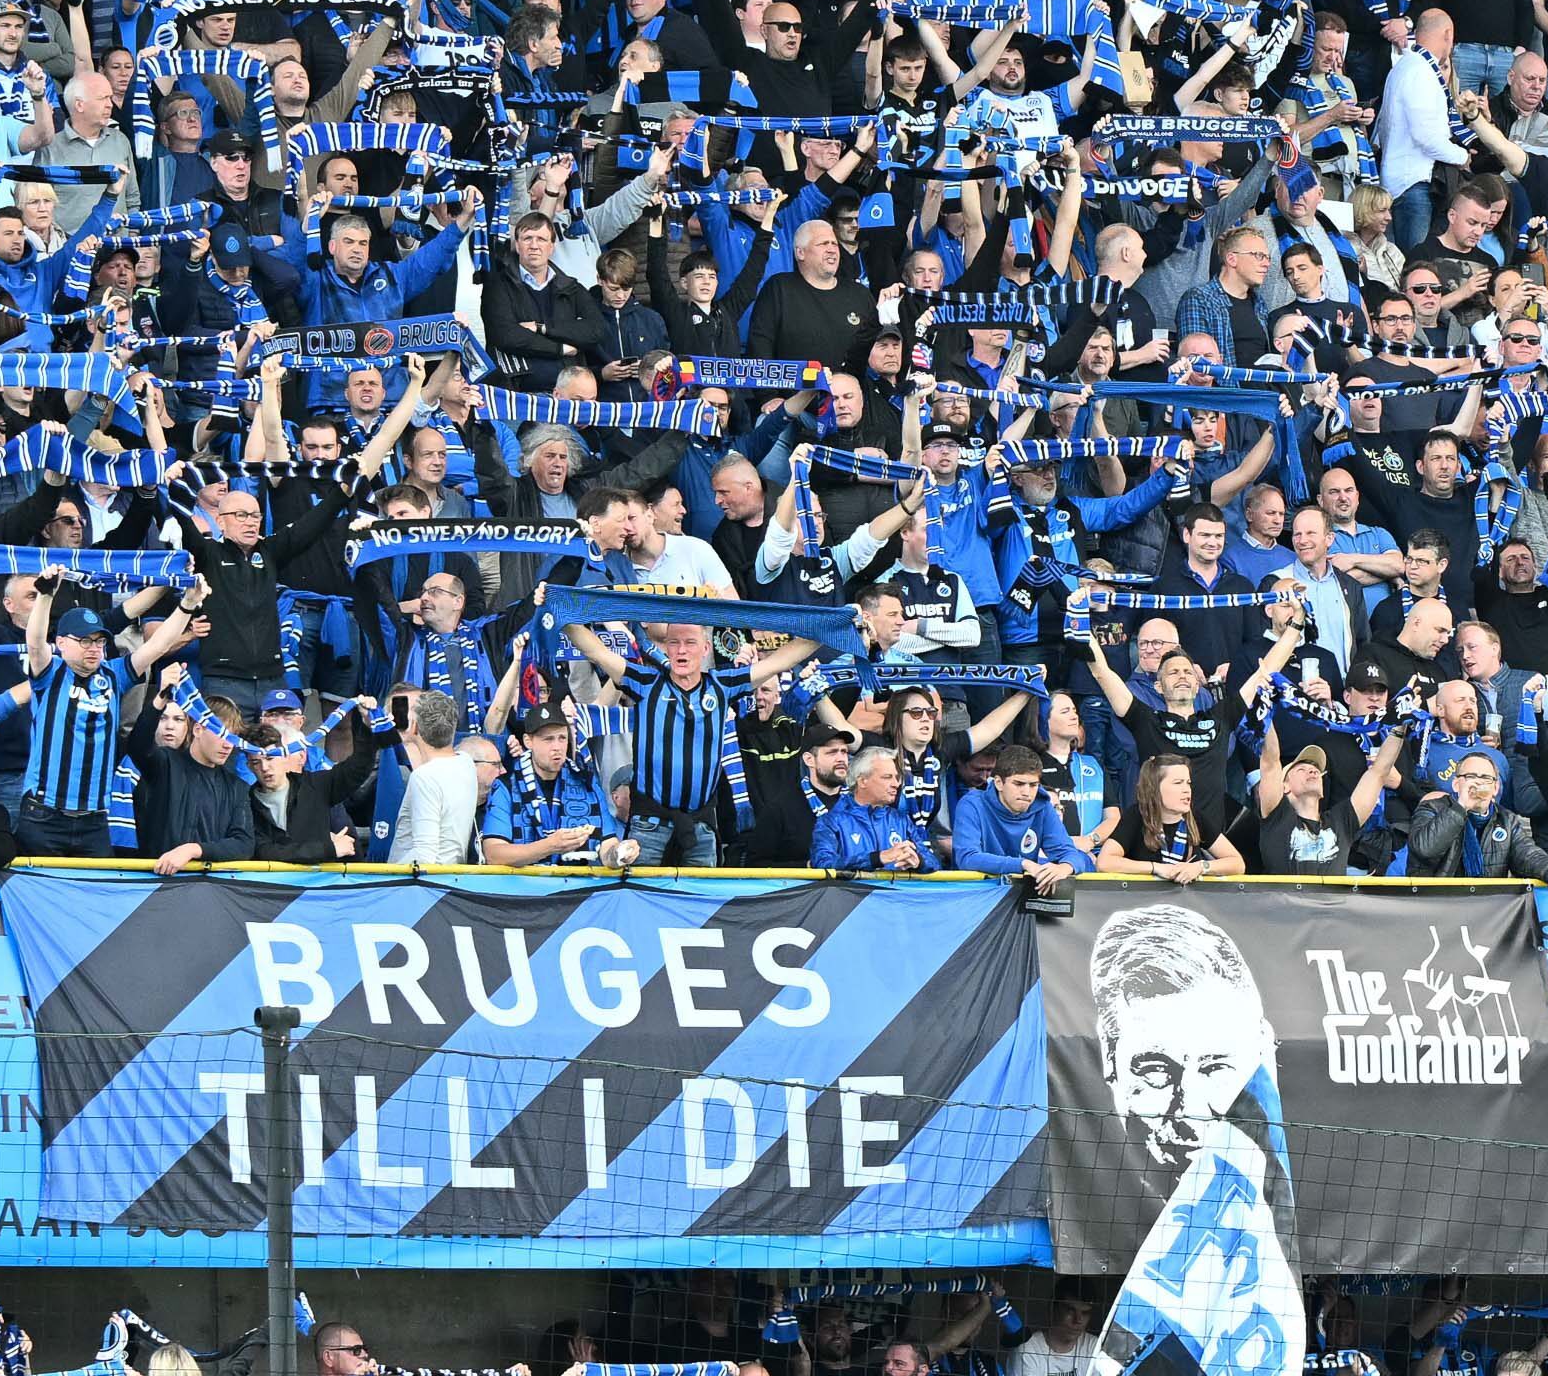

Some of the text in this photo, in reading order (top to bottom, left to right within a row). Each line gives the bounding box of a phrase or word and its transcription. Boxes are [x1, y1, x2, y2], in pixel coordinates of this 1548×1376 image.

[1090, 174, 1192, 202] BRUGGE
[699, 360, 799, 381] BRUGGE
[374, 525, 580, 545] NO GLORY
[244, 921, 832, 1029] BRUGES
[1305, 948, 1393, 1016] The
[1321, 1012, 1531, 1087] Godfather
[198, 1068, 908, 1191] TILL I DIE
